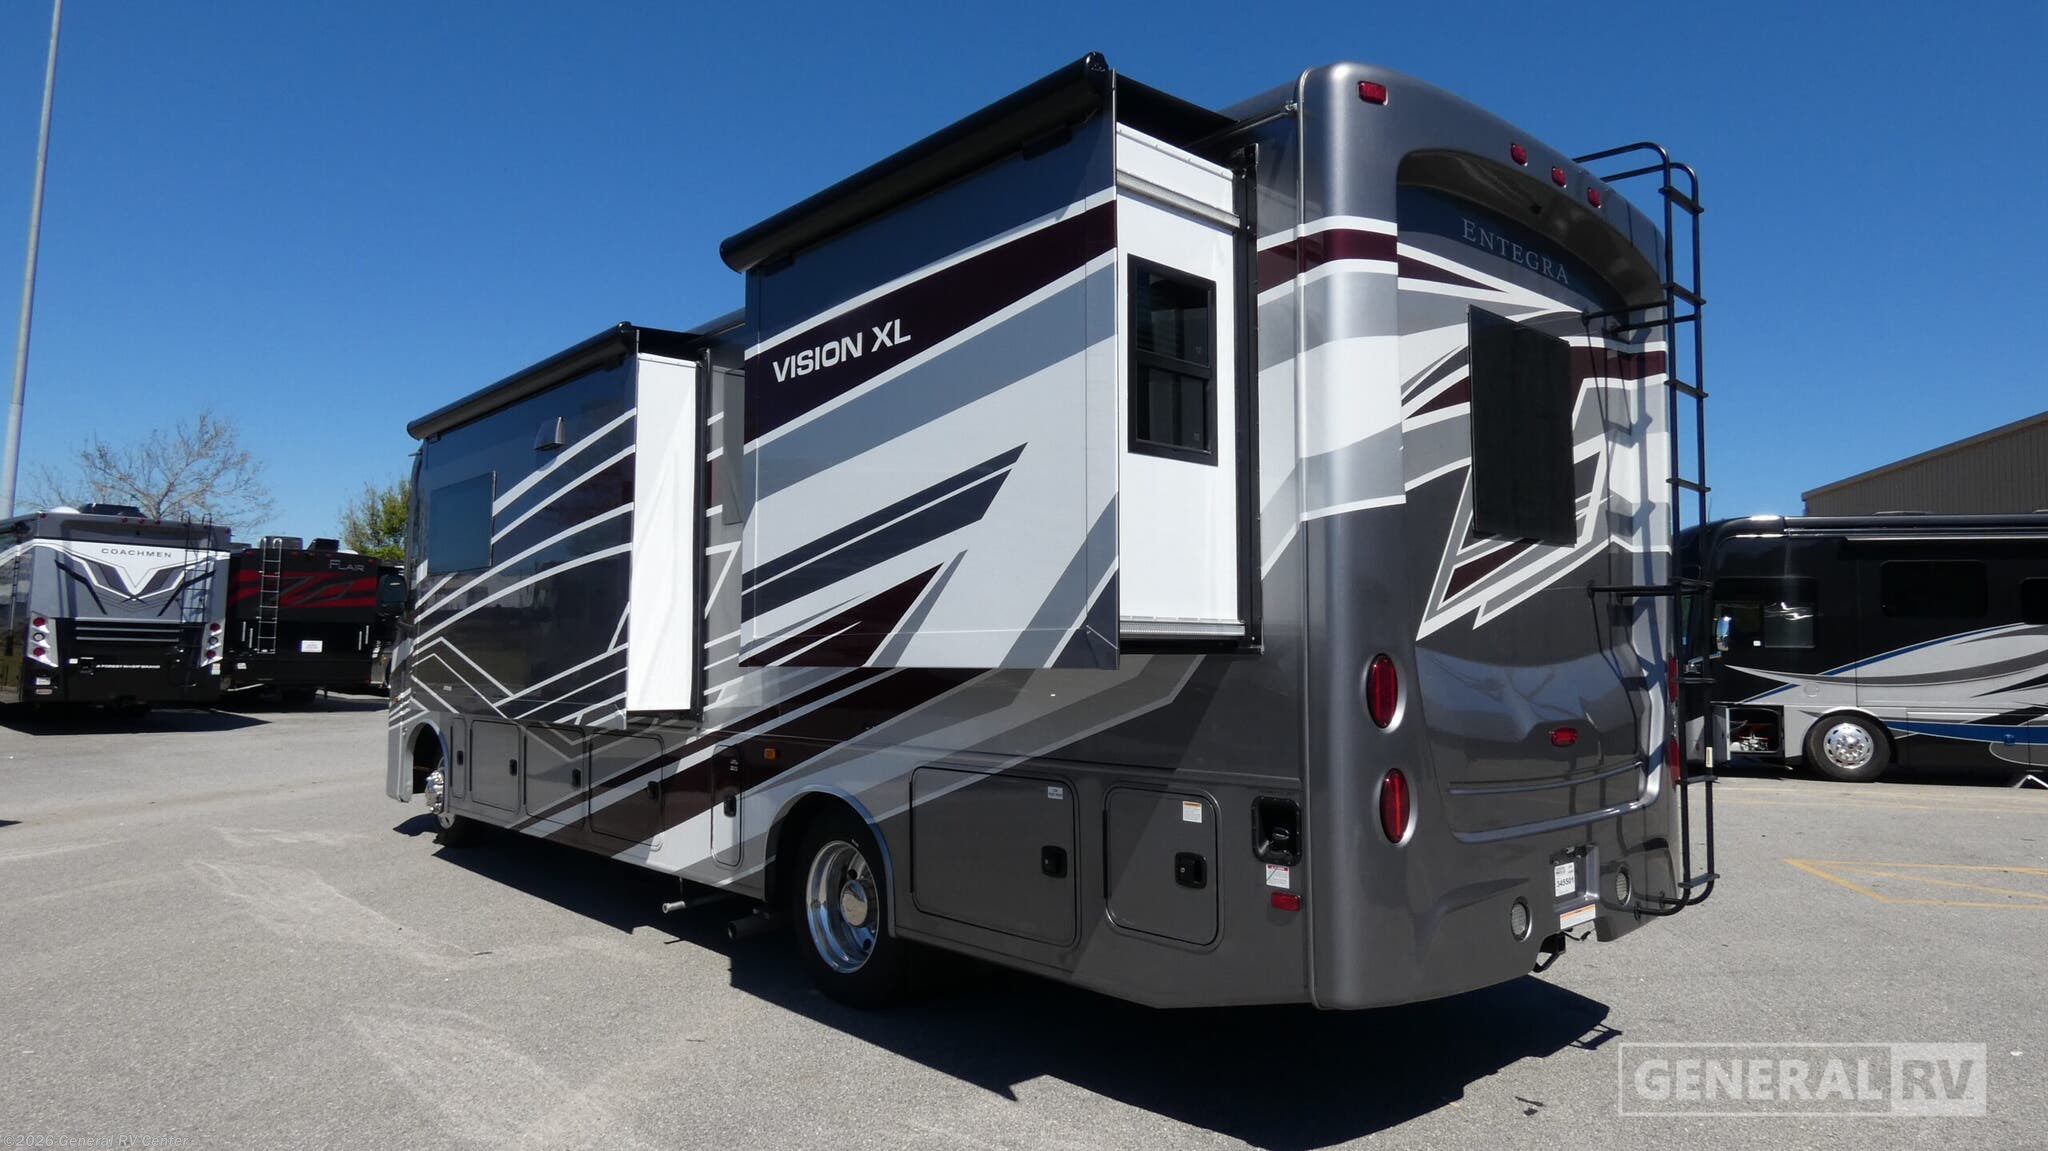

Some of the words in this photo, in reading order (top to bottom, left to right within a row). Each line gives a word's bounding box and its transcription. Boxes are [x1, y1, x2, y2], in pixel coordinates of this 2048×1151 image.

[1462, 218, 1569, 285] ENTEGRA
[772, 332, 863, 383] VISION
[870, 318, 912, 353] XL
[101, 547, 172, 559] COACHMEN
